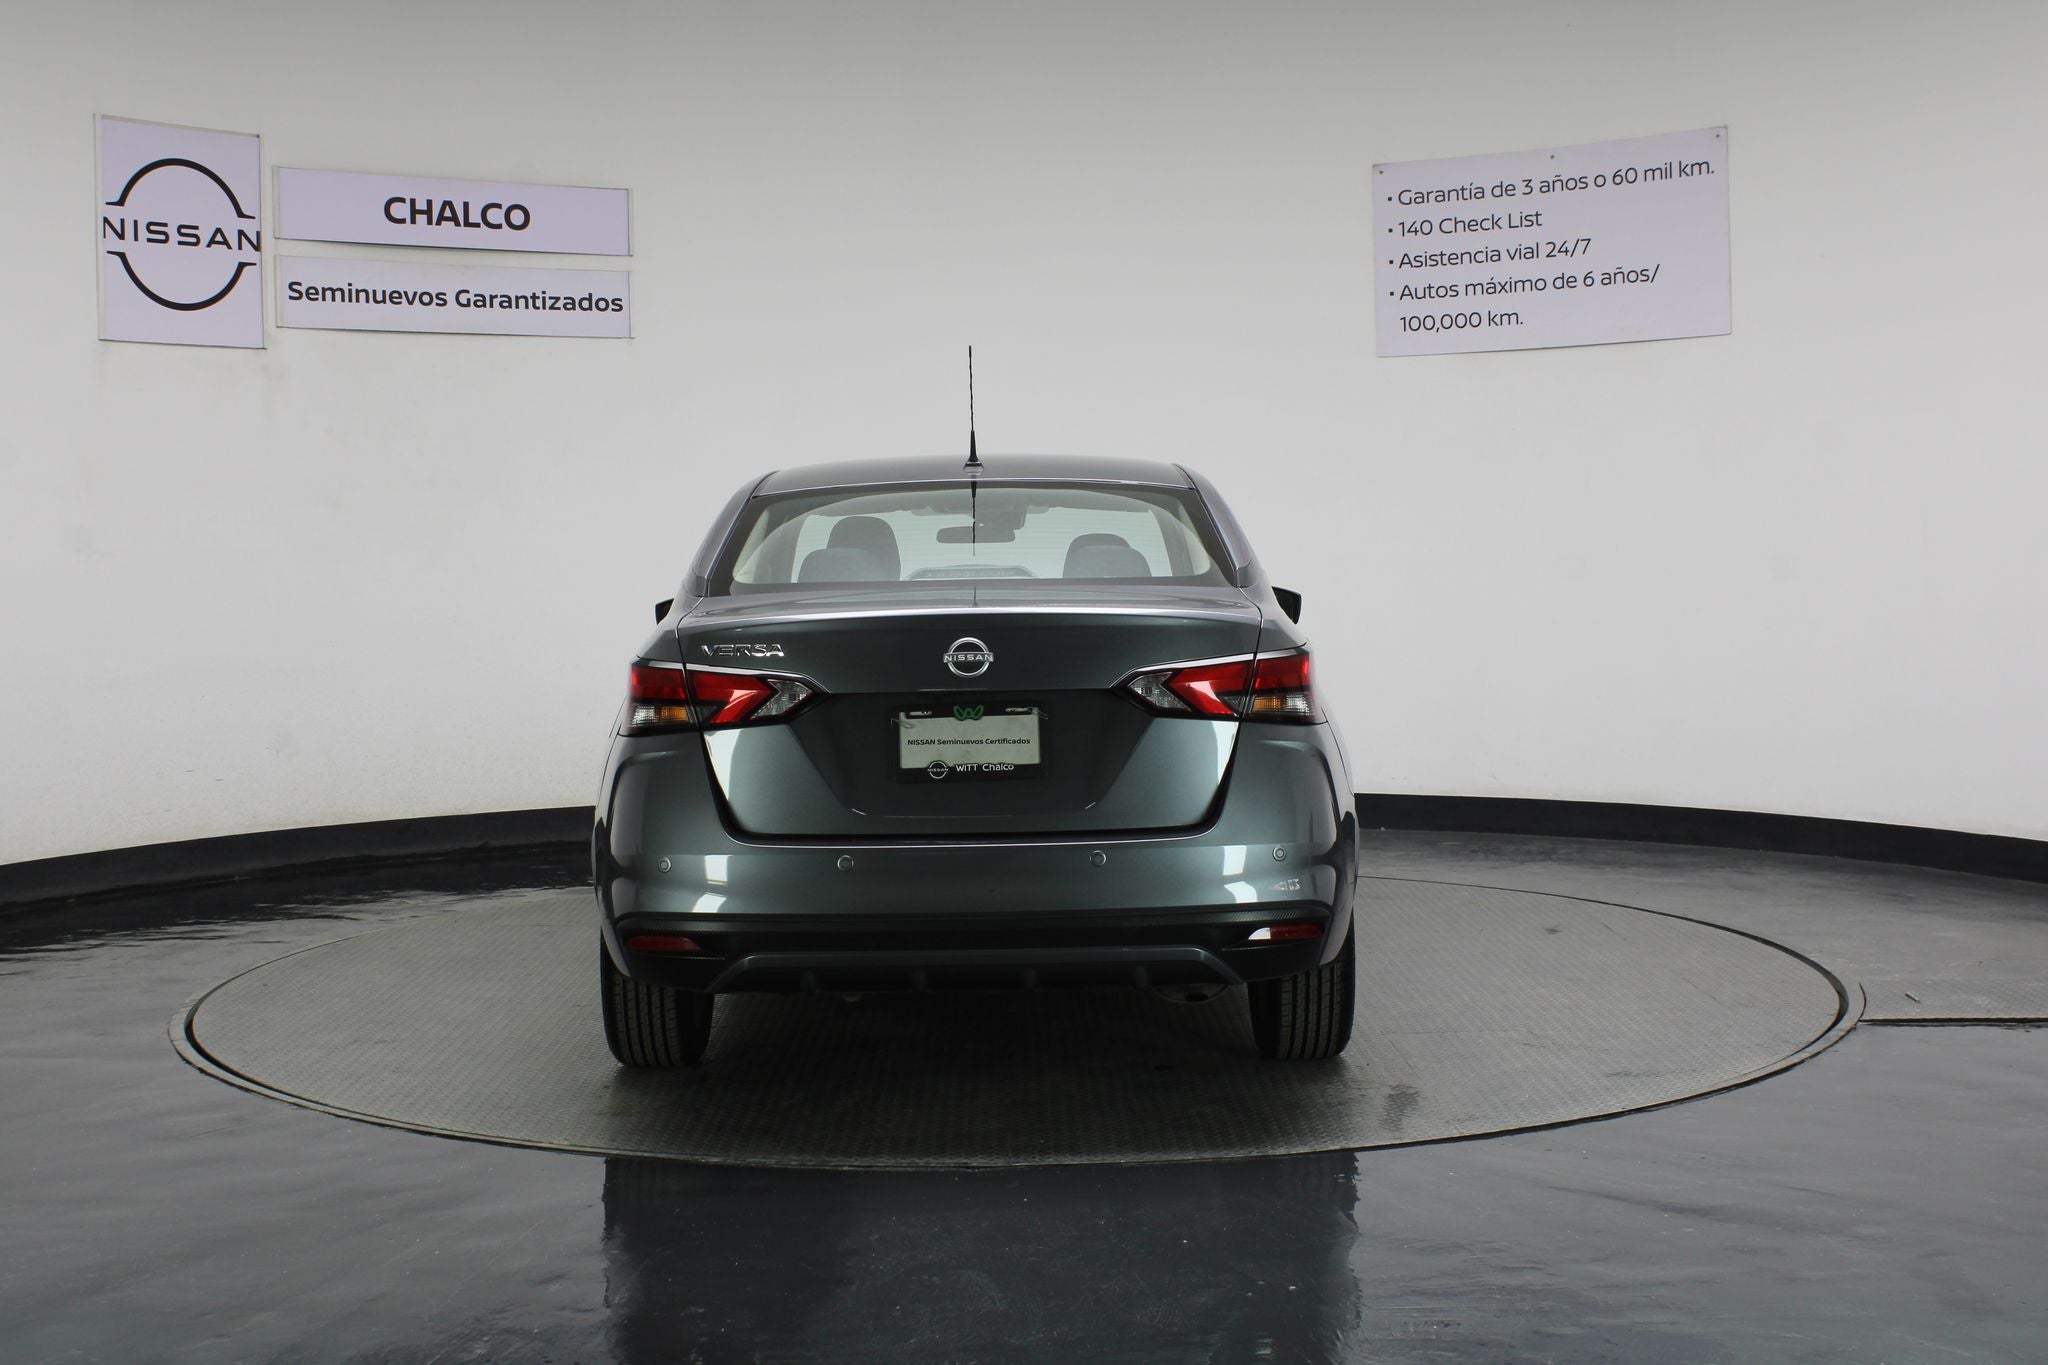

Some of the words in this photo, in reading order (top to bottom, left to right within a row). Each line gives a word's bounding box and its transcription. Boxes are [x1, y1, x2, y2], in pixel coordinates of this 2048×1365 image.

[1398, 184, 1485, 206] Garantía
[1491, 181, 1516, 199] de
[1522, 179, 1534, 195] 3
[1540, 174, 1589, 194] años
[1594, 175, 1607, 188] o
[1612, 168, 1638, 186] 60
[1644, 162, 1673, 183] mil
[1679, 160, 1715, 179] km.
[384, 197, 531, 231] CHALCO
[1398, 219, 1433, 238] 140
[1438, 214, 1503, 236] Check
[1508, 211, 1543, 229] List
[103, 217, 261, 252] NISSAN
[1399, 248, 1502, 269] Asistencia
[1507, 242, 1540, 261] vial
[1545, 238, 1592, 259] 24/7
[288, 281, 449, 308] Seminuevos
[455, 289, 624, 312] Garantizados
[1400, 283, 1460, 301] Autos
[1464, 277, 1547, 298] máximo
[1553, 273, 1578, 290] de
[1583, 271, 1595, 288] 6
[1600, 264, 1661, 287] años/
[1400, 312, 1482, 334] 100,000
[1488, 310, 1524, 327] km.
[701, 643, 785, 657] VERSA
[945, 653, 993, 662] NISSAN
[907, 738, 936, 746] NISSAN
[936, 738, 984, 746] Seminuevos
[985, 737, 1031, 746] Certificados
[955, 763, 979, 773] WITT
[982, 762, 1015, 772] Chalco
